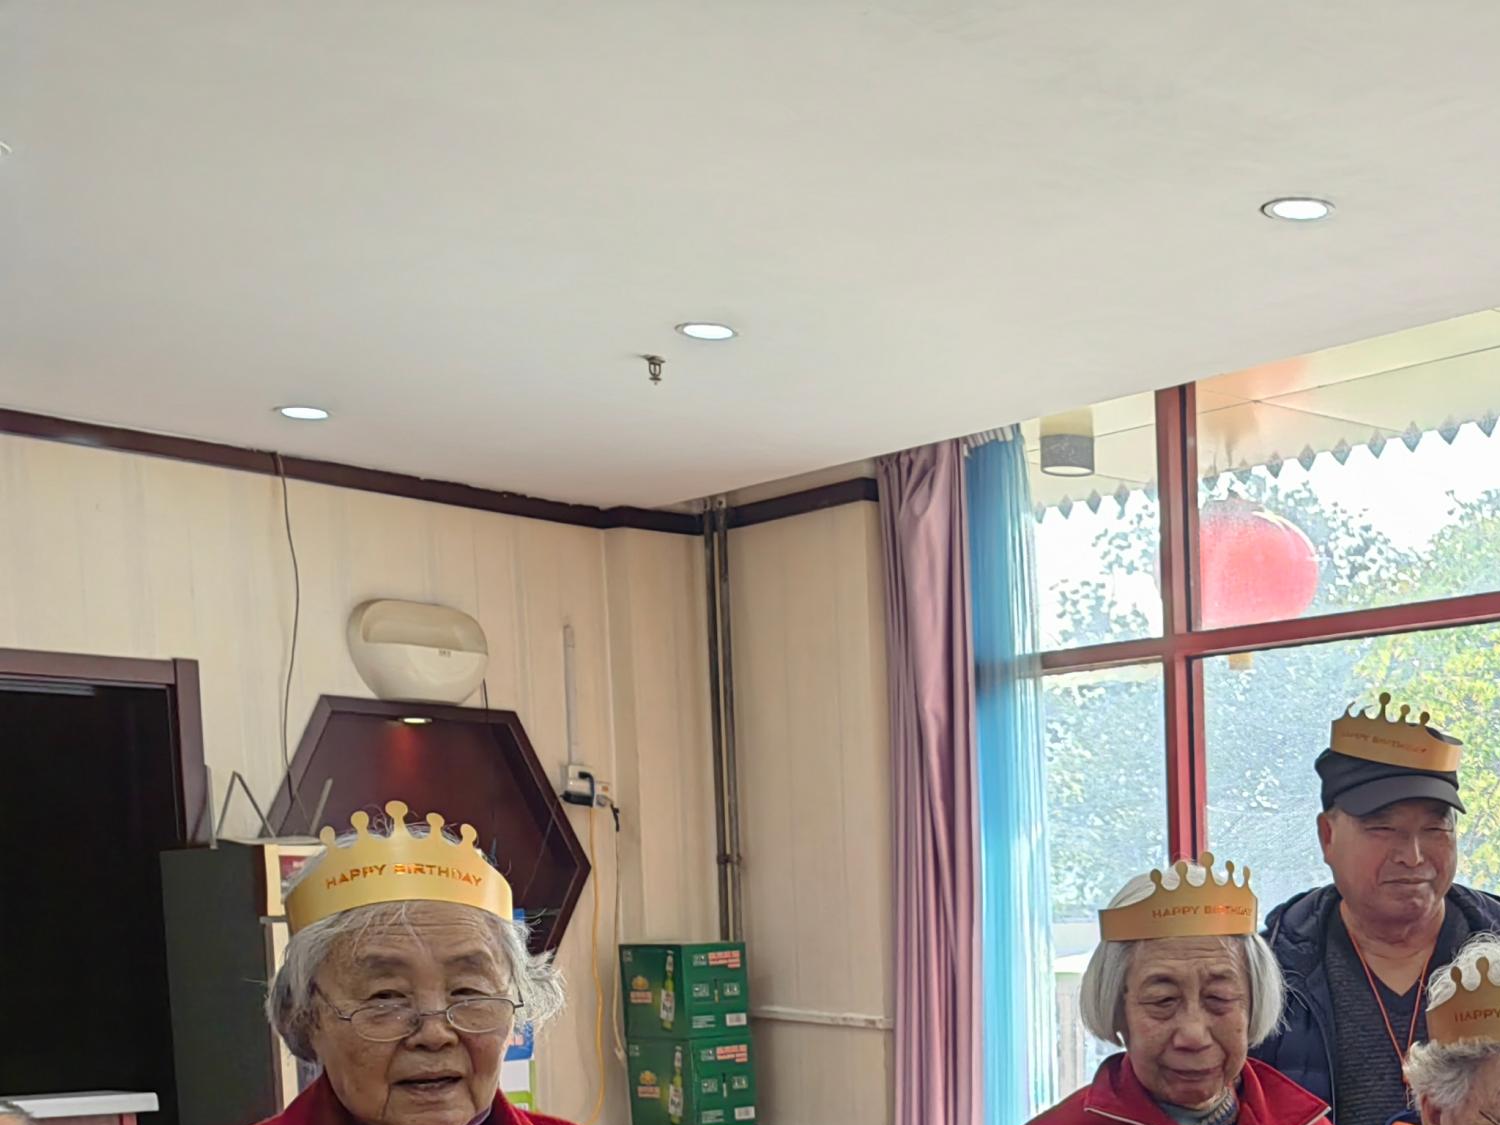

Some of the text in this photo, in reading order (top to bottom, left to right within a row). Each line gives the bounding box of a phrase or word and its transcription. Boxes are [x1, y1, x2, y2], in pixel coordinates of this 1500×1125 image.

[325, 862, 483, 891] HAPPY BIRTHDAY
[1152, 905, 1200, 919] HAPPY
